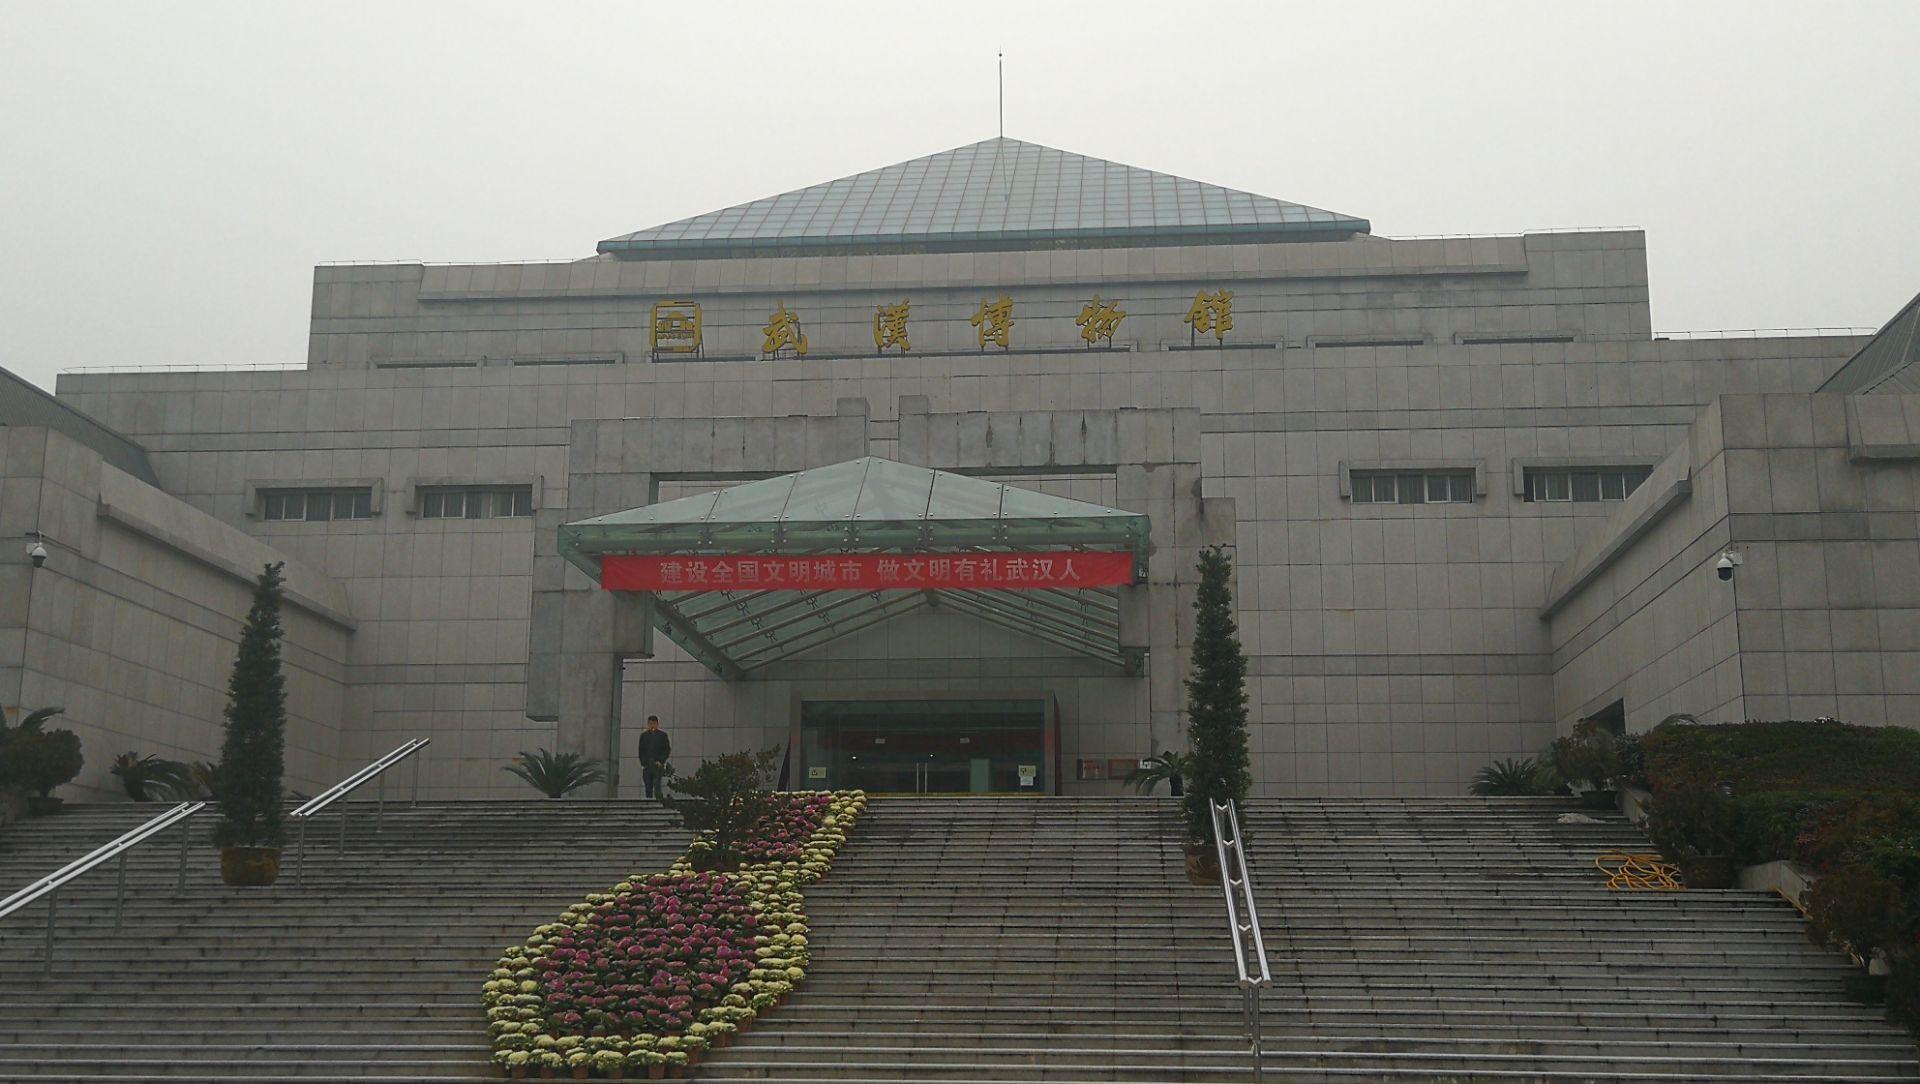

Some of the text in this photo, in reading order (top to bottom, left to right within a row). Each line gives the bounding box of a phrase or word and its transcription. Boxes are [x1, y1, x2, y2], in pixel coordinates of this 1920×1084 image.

[762, 288, 1234, 355] 武漢博物館
[660, 558, 1081, 584] 建设全国文明城市 做文明有礼武汉人
